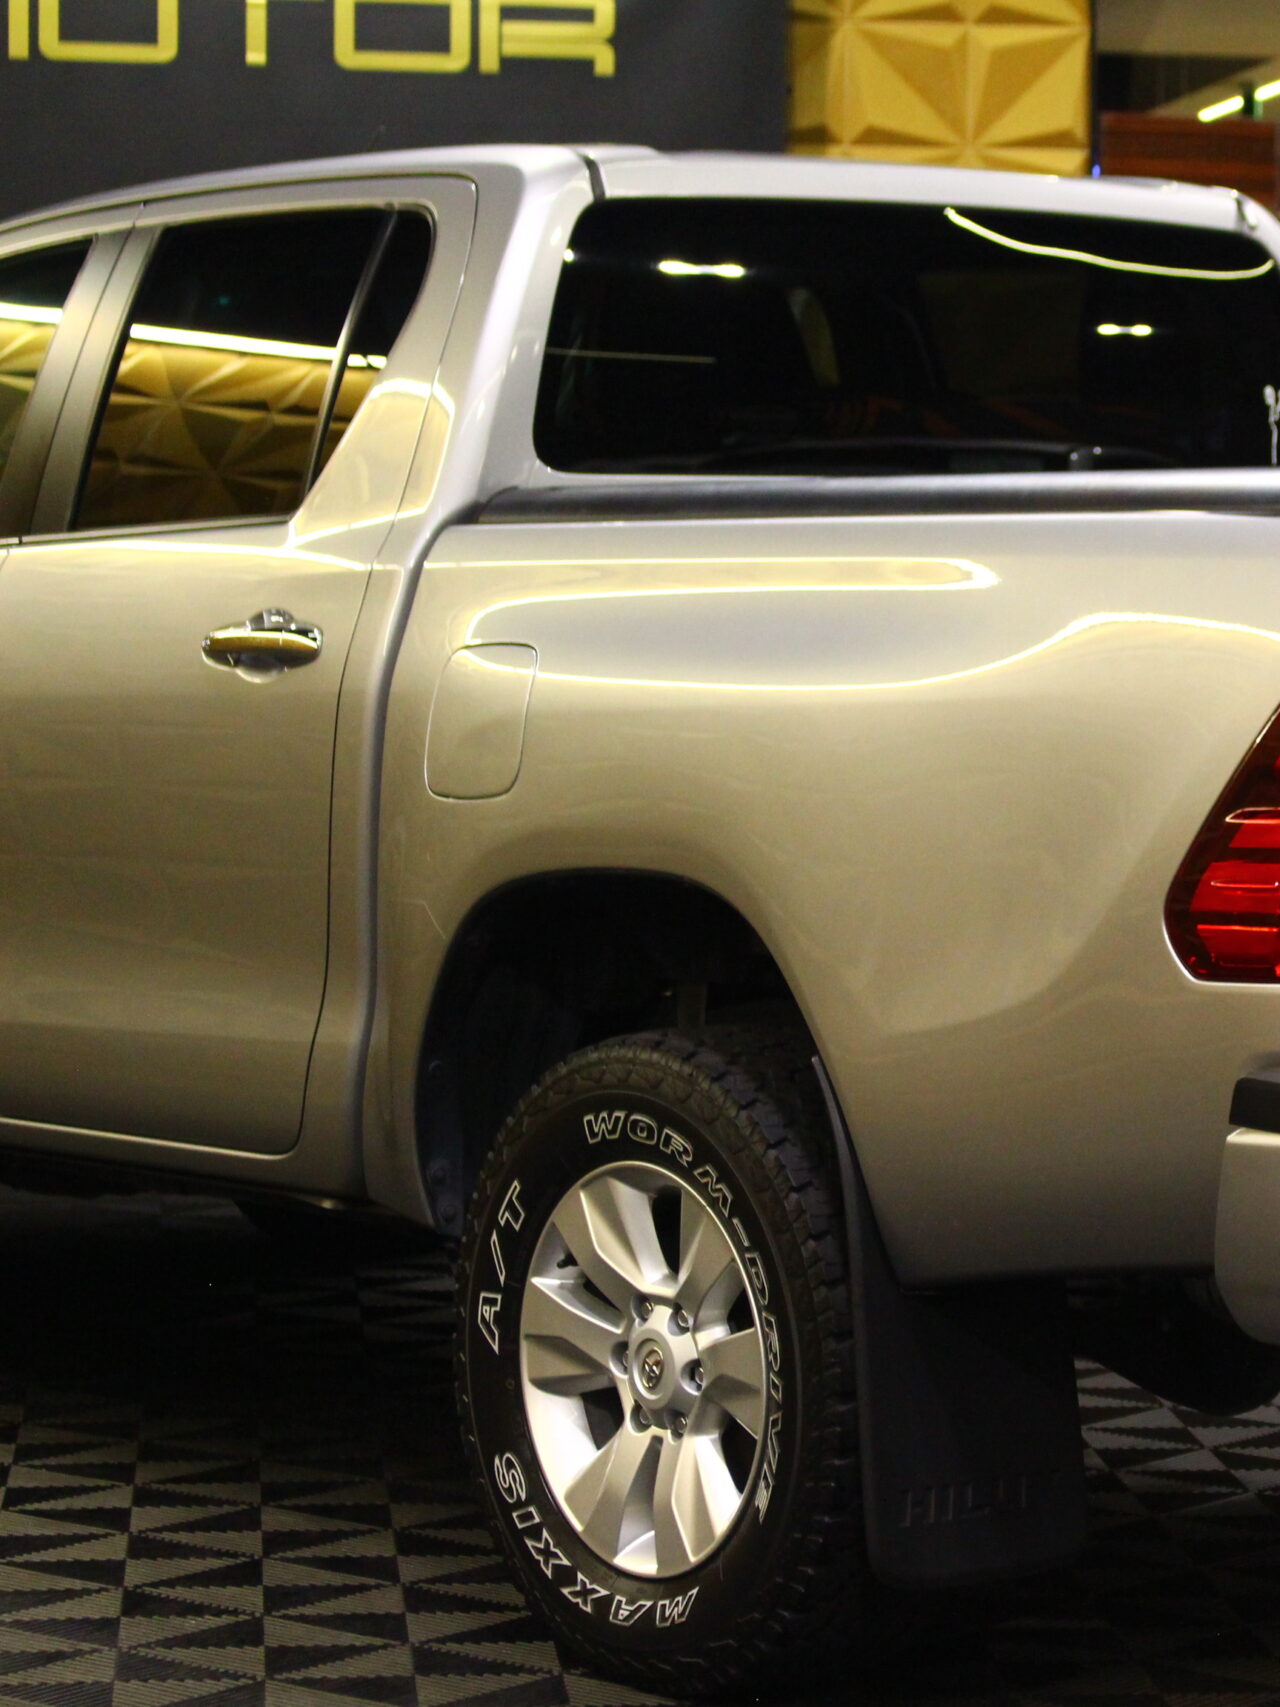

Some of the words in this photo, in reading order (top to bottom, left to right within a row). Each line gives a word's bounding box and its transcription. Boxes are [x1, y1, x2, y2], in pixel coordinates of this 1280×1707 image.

[8, 0, 616, 77] OTOR
[477, 1180, 526, 1354] A/T
[494, 1452, 698, 1627] MAXXIS
[898, 1470, 1058, 1528] HILU
